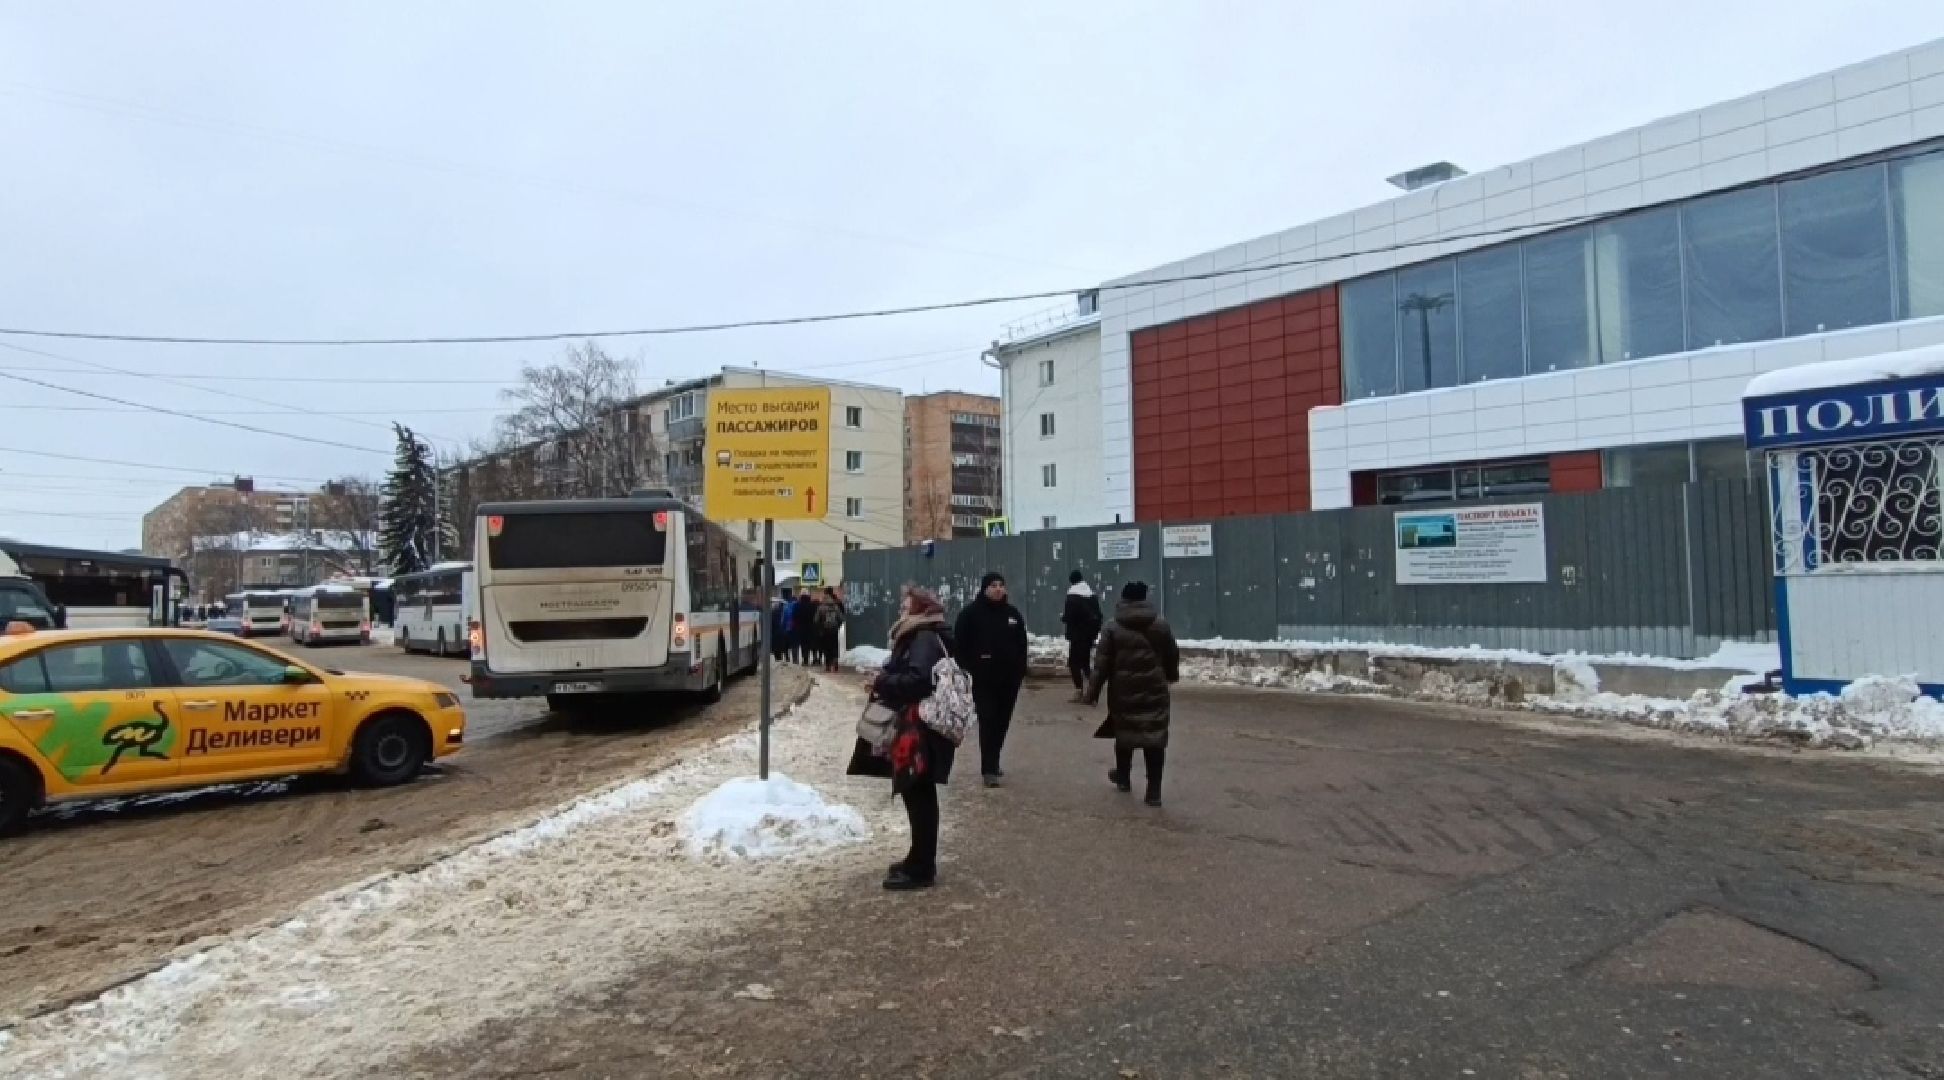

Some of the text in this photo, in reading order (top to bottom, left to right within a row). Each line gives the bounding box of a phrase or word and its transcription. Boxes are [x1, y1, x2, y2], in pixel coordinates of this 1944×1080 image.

[717, 400, 820, 414] Место высадки
[717, 419, 818, 433] ПАССАЖИРОВ
[224, 701, 321, 723] Маркет
[185, 726, 321, 754] Деливери
